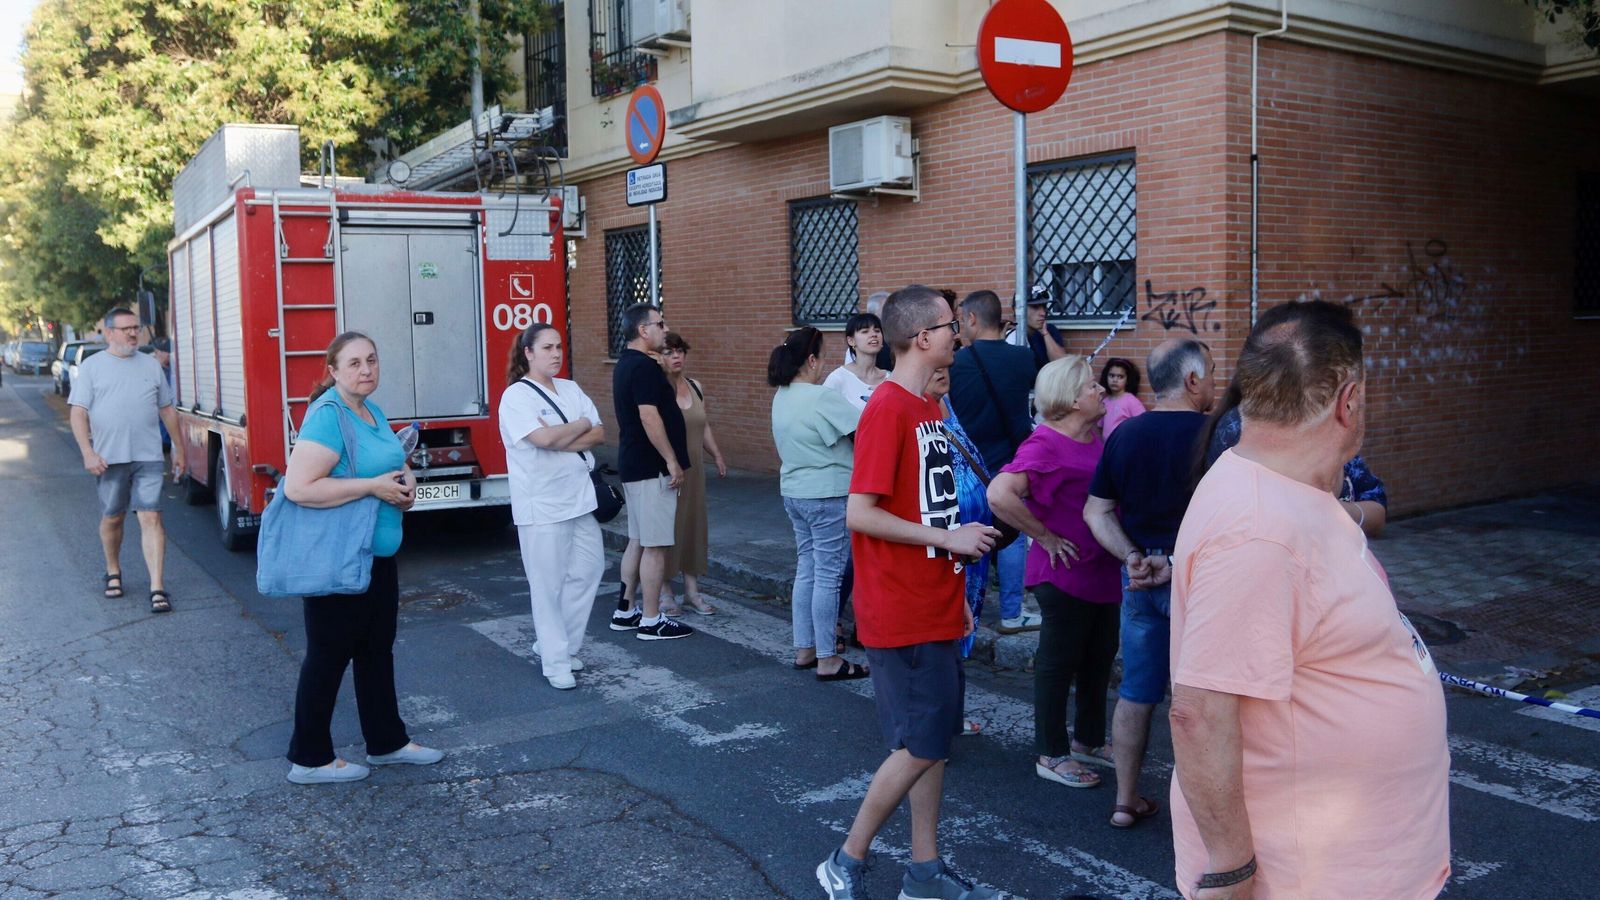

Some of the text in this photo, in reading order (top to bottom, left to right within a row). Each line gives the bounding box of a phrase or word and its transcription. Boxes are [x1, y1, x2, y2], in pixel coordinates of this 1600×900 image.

[493, 303, 553, 331] 080
[417, 486, 441, 500] 962
[1440, 671, 1476, 689] PASA
